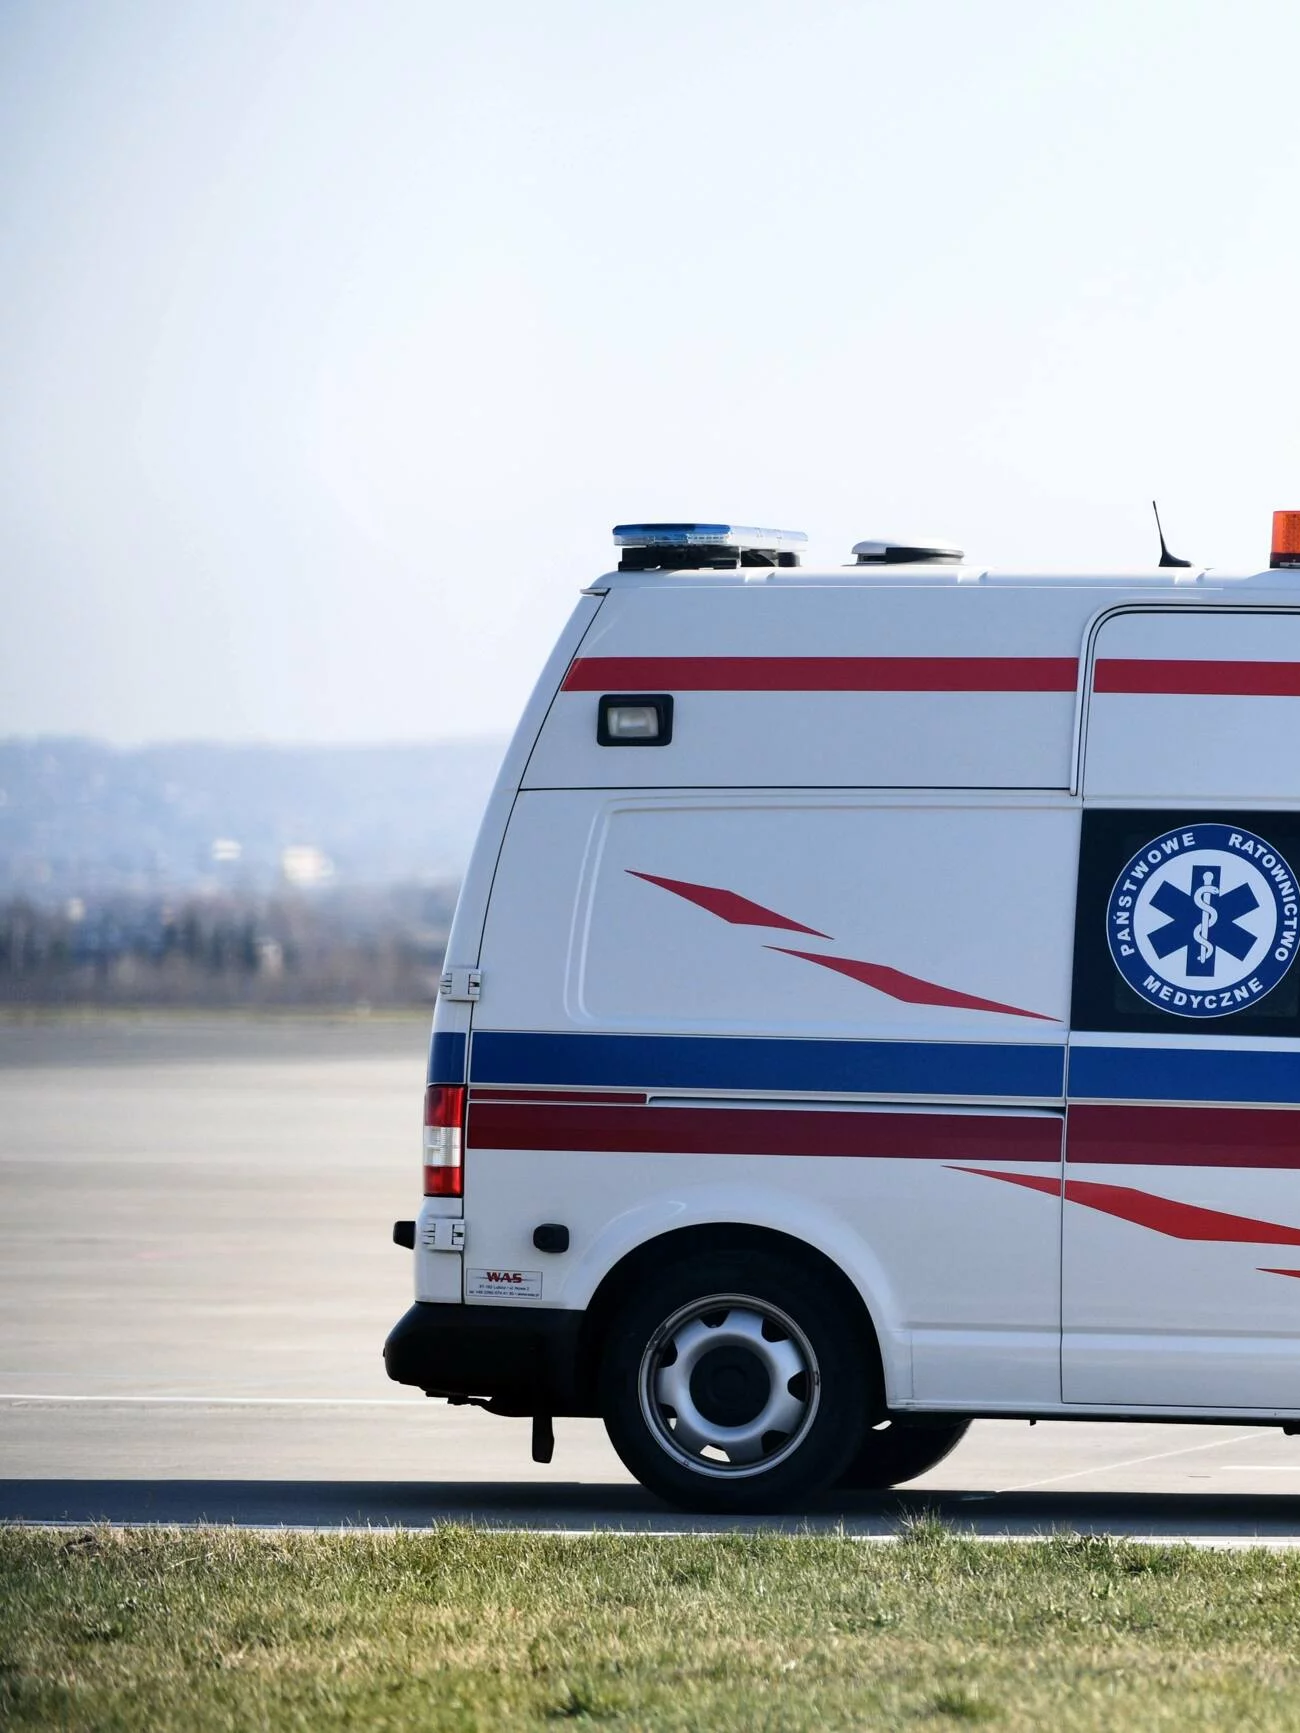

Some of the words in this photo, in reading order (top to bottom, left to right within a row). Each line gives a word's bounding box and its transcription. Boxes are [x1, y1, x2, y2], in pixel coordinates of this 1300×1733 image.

[1115, 832, 1196, 957] PAŃSTWOWE
[1227, 832, 1299, 962] RATOWNICTWO
[1142, 974, 1264, 1010] MEDYCZNE
[486, 1271, 523, 1284] WAS
